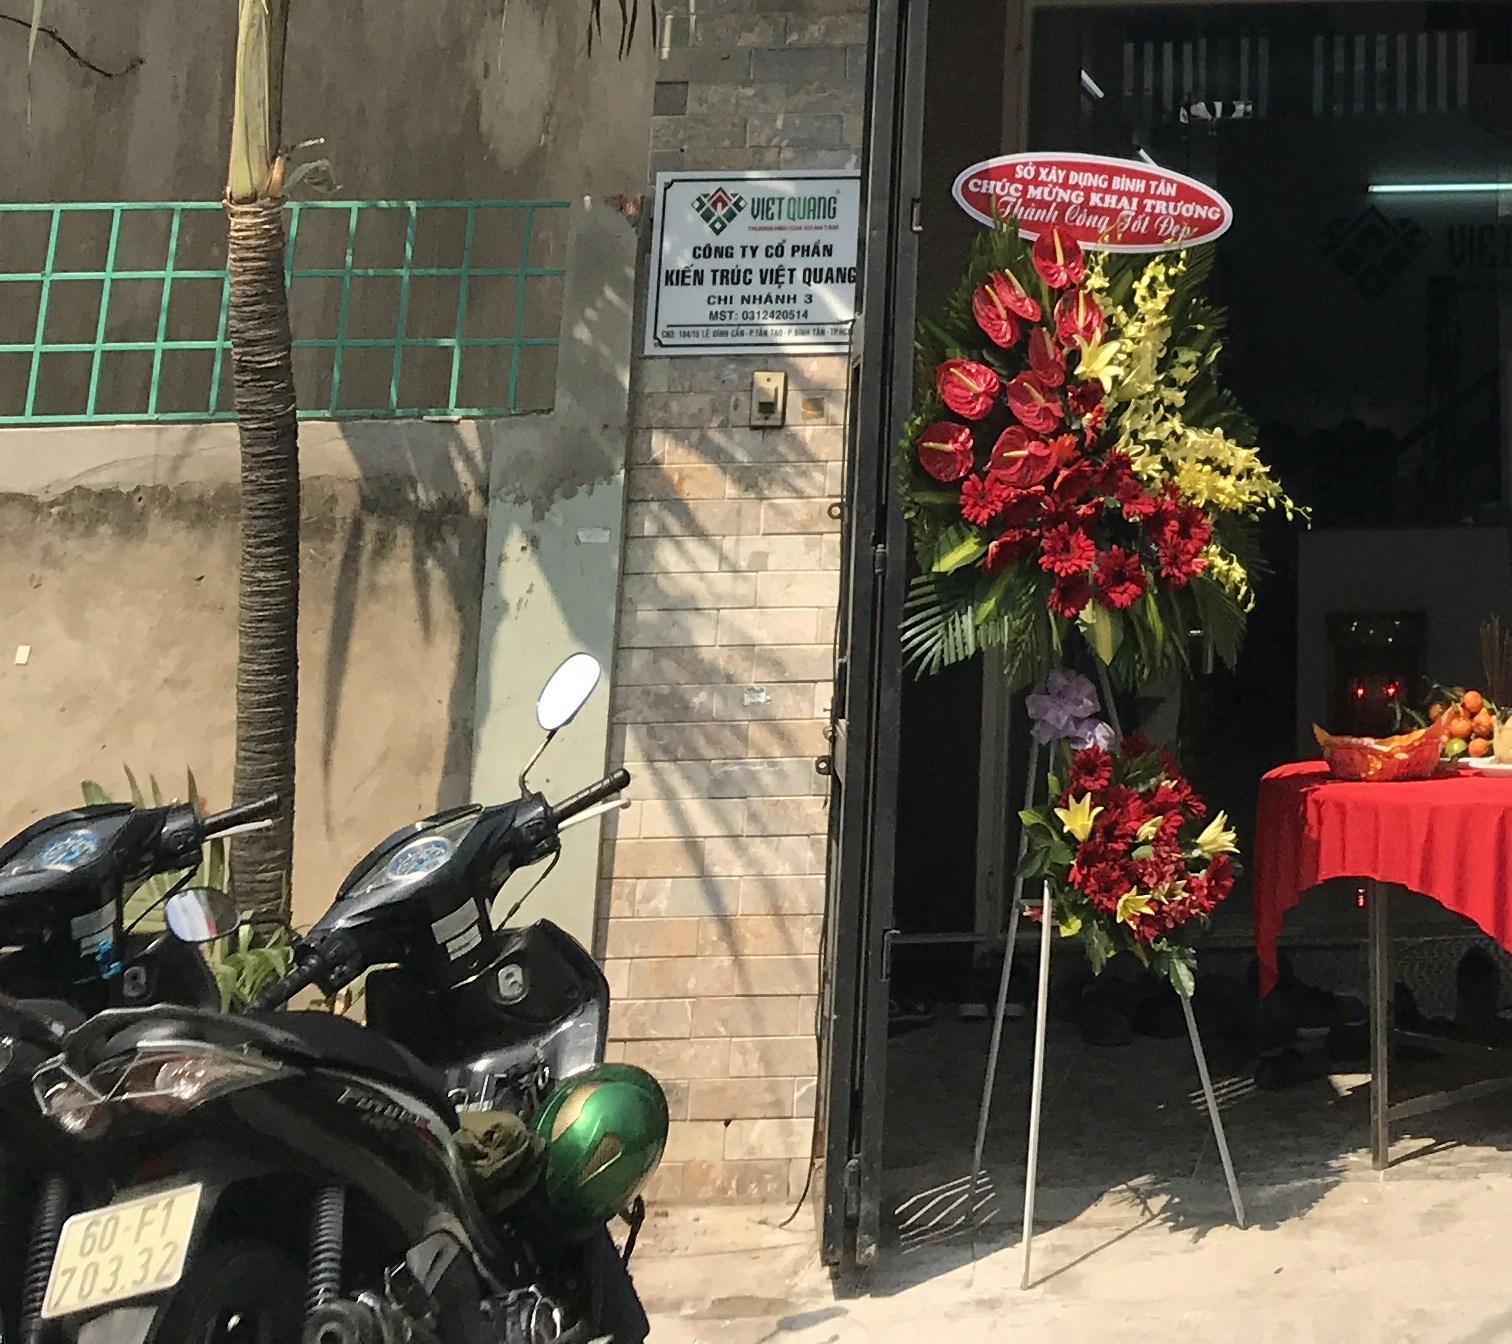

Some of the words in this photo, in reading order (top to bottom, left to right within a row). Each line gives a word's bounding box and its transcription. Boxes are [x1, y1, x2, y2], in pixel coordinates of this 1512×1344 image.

[1014, 161, 1037, 180] SỞ
[1038, 165, 1067, 184] XÂY
[1111, 173, 1146, 193] BÌNH
[1149, 178, 1178, 197] TÂN
[750, 196, 784, 222] VIET
[786, 195, 838, 222] QUANG
[968, 177, 1023, 198] CHÚC
[1026, 183, 1085, 205] MỪNG
[1088, 192, 1139, 211] KHAI
[1064, 203, 1110, 234] Công
[1116, 209, 1151, 234] Tốt
[692, 242, 734, 260] CÔNG
[739, 244, 759, 259] TY
[764, 239, 787, 259] CỔ
[664, 263, 705, 287] KIẾN
[710, 263, 753, 287] TRÚC
[759, 264, 797, 289] VIỆT
[802, 266, 858, 287] QUANG
[706, 294, 734, 306] CHI
[740, 292, 797, 306] NHÁNH
[803, 294, 813, 305] 3
[708, 310, 738, 321] MST:
[741, 309, 808, 321] 0312420514
[78, 1198, 176, 1259] 60-F1
[53, 1240, 179, 1310] 703.32
